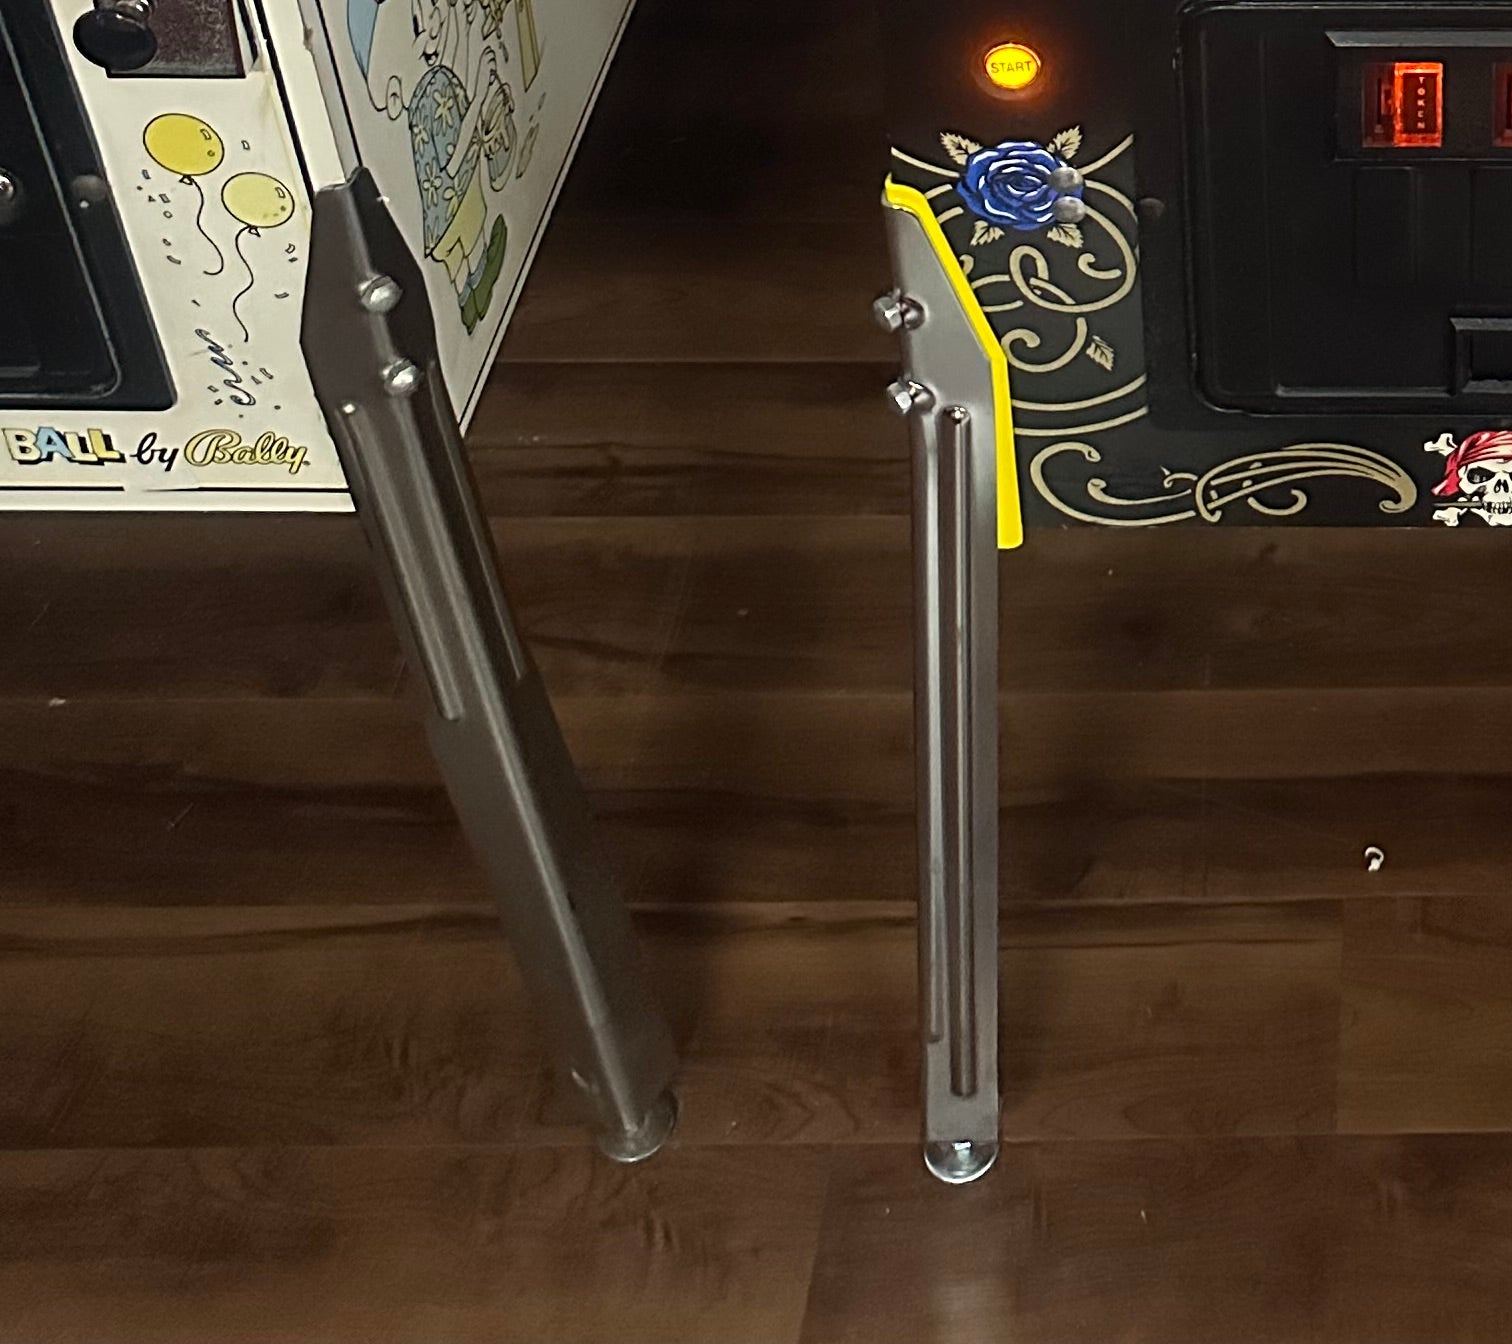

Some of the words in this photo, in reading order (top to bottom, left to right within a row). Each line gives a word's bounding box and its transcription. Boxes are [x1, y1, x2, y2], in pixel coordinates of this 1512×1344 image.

[991, 60, 1031, 73] START
[1417, 77, 1426, 129] TOKEN
[1, 426, 127, 465] BALL
[130, 432, 179, 471] by
[184, 428, 309, 474] Bally
